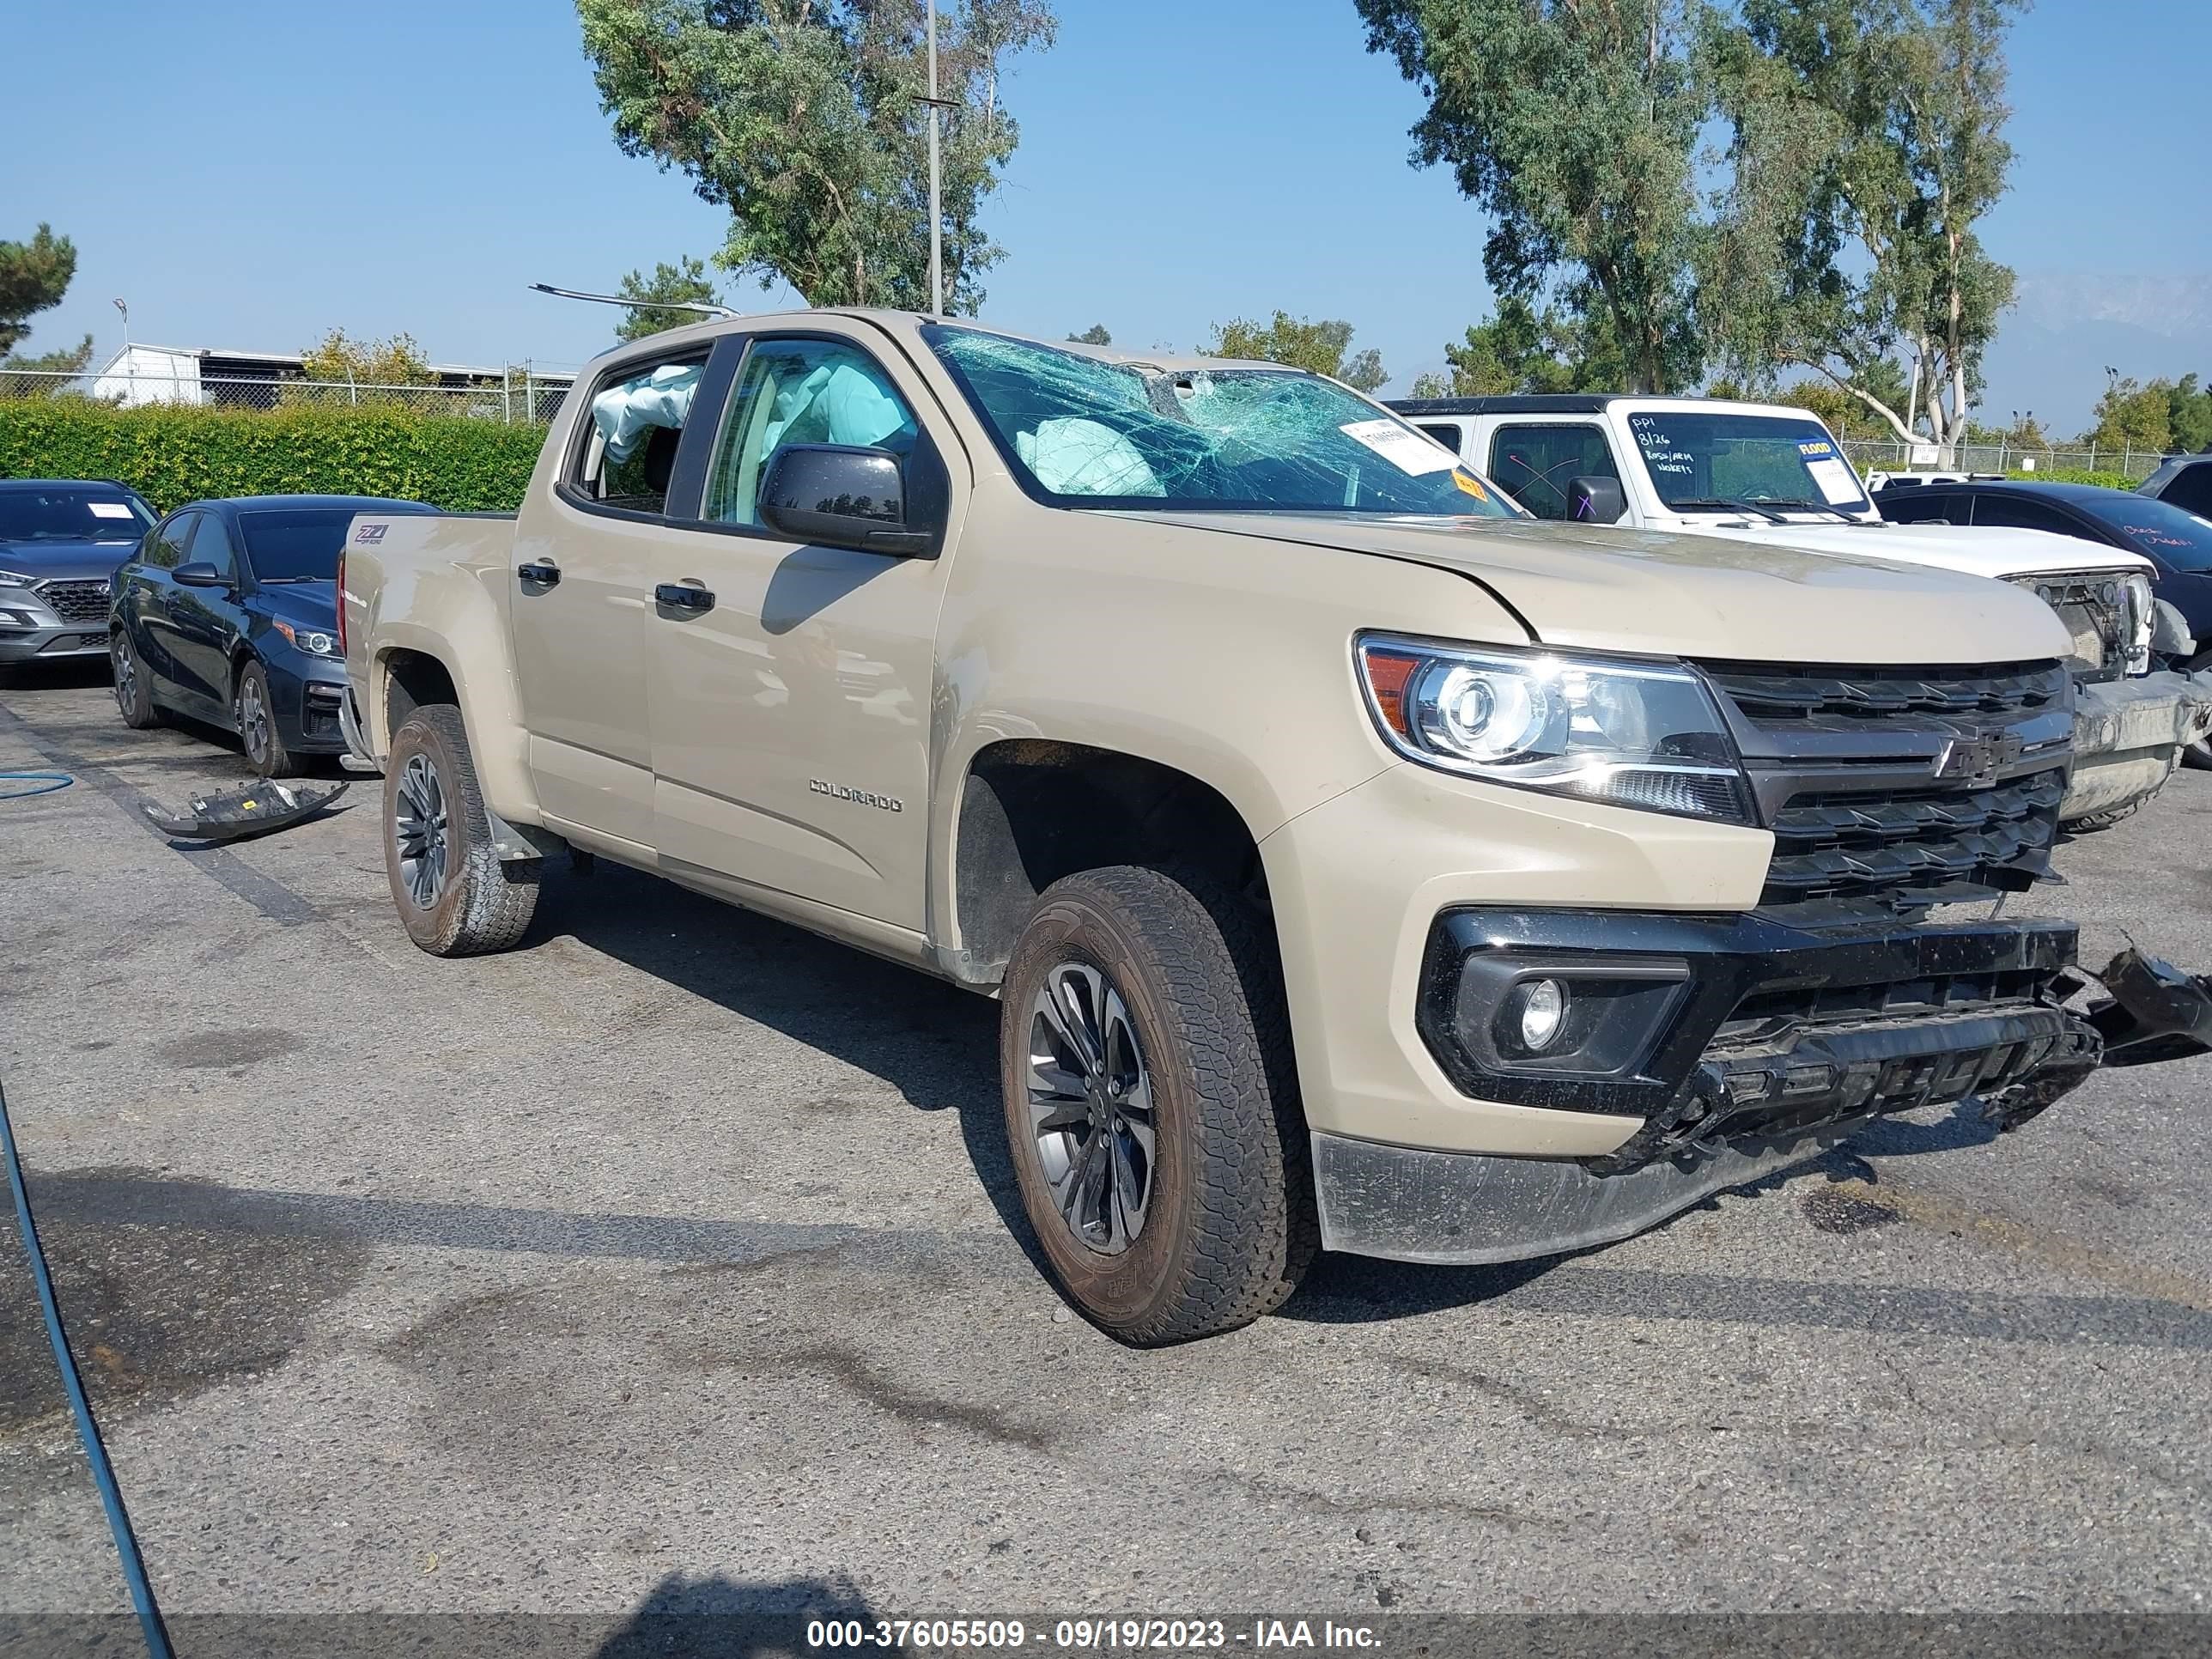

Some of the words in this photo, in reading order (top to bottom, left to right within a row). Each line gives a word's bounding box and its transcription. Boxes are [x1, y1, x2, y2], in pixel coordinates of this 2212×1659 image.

[1638, 432, 1670, 447] 8/26
[1798, 442, 1832, 454] FLOOD
[355, 525, 389, 542] Z71
[810, 779, 902, 812] COLORADO
